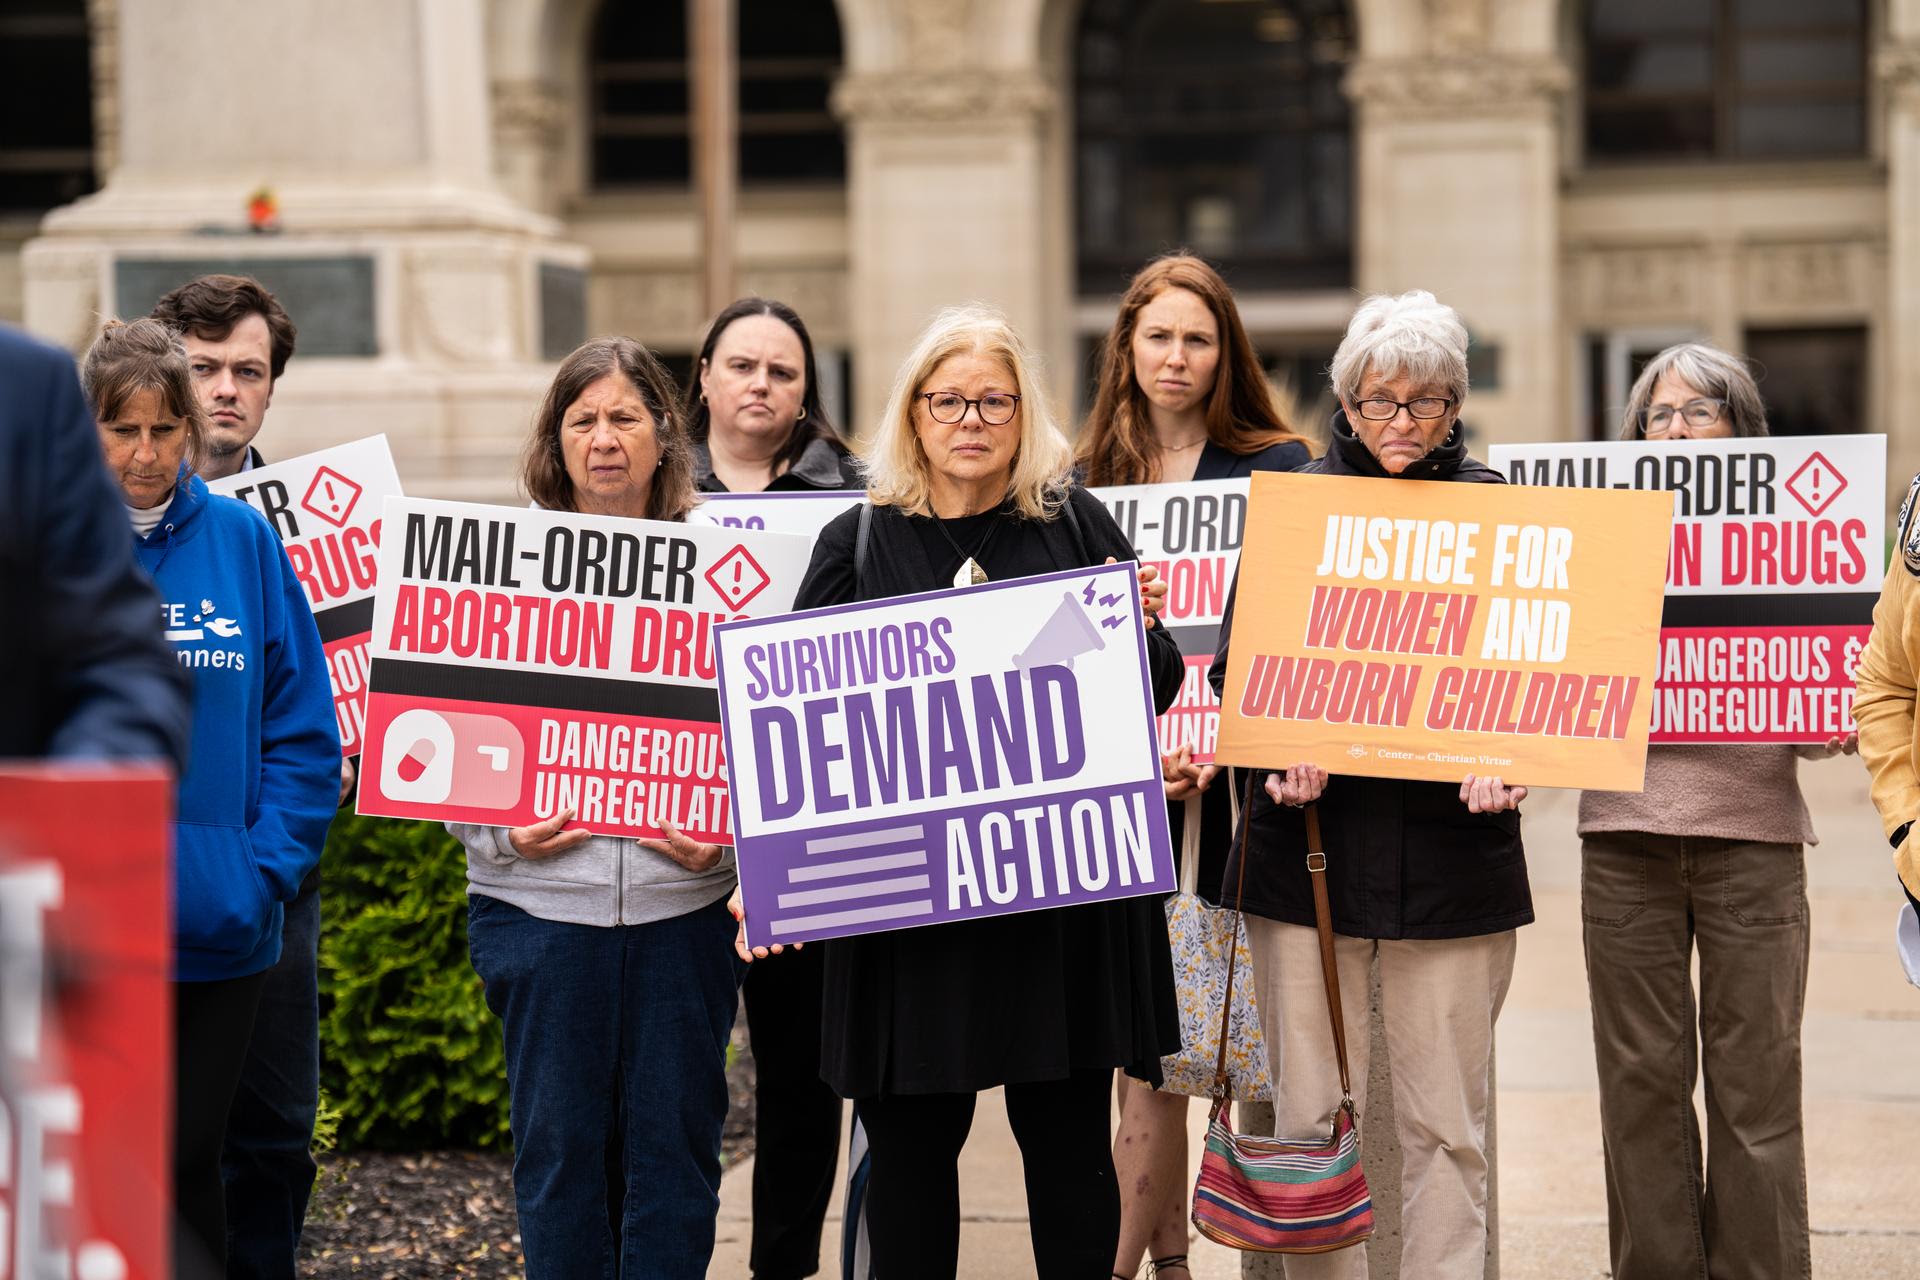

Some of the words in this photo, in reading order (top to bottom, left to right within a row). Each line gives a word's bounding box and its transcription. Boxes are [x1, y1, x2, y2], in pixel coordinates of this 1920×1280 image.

[402, 513, 697, 604] MAIL-ORDER
[1317, 514, 1480, 585] JUSTICE
[1491, 525, 1573, 589] FOR
[1721, 518, 1867, 586] DRUGS
[389, 585, 615, 671] ABORTION
[631, 606, 752, 681] DRU
[743, 616, 956, 702] SURVIVORS
[1304, 585, 1478, 656] WOMEN
[1481, 597, 1571, 663] AND
[1241, 655, 1422, 728] UNBORN
[1425, 667, 1641, 740] CHILDREN
[750, 664, 1086, 822] DEMAND
[1377, 748, 1414, 761] Center
[1427, 752, 1476, 765] Christian
[1479, 755, 1513, 767] Virtue
[947, 791, 1155, 912] ACTION
